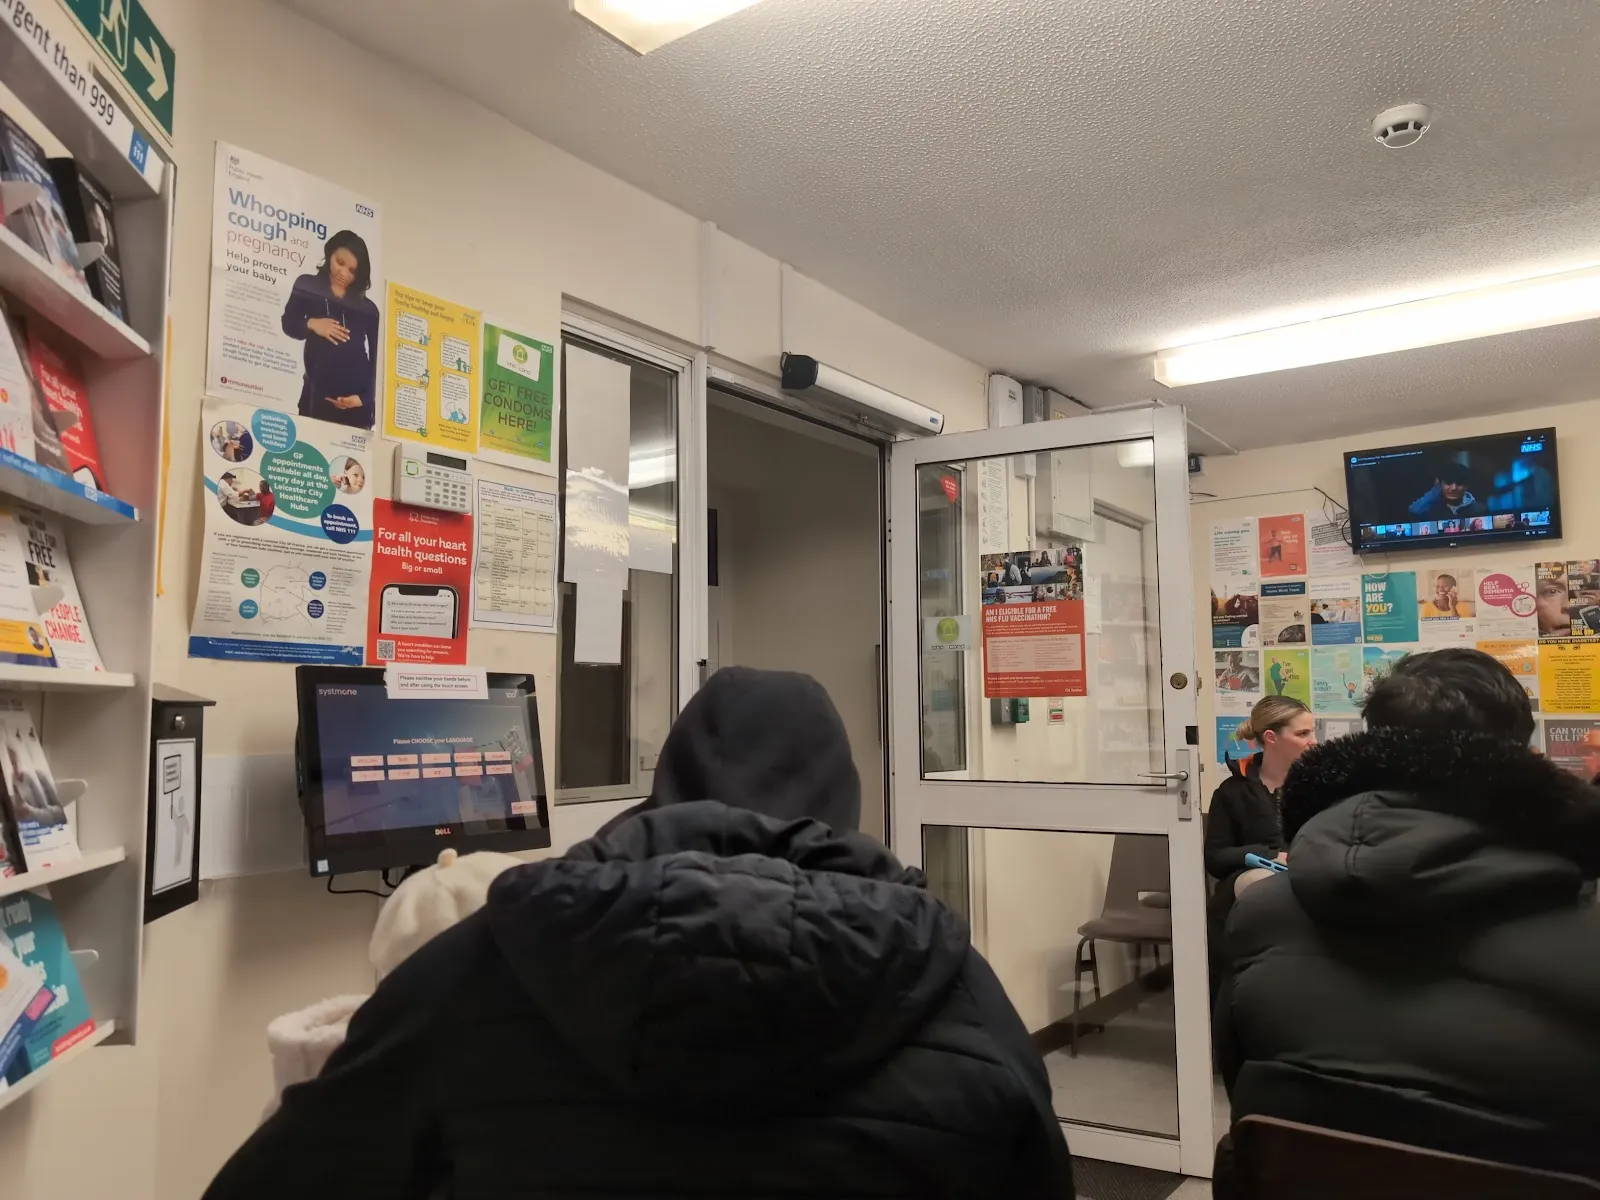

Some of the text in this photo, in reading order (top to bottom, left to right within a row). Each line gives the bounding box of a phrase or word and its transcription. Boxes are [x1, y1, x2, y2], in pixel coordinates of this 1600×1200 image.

[0, 0, 115, 126] rgent than 999
[133, 146, 144, 165] 111
[228, 187, 327, 240] Whooping
[356, 204, 374, 218] NHS
[228, 211, 309, 249] cough and
[227, 229, 306, 268] pregnancy
[226, 249, 288, 276] Help protect
[226, 262, 277, 285] your baby
[488, 378, 549, 406] GET FREE
[483, 392, 552, 421] CONDOMS
[260, 414, 287, 425] Including
[498, 411, 537, 433] HERE!
[260, 426, 288, 437] weekends
[262, 438, 286, 449] holidays
[1523, 443, 1542, 452] NHS
[272, 458, 323, 473] appointments
[267, 465, 329, 483] available all day,
[268, 474, 289, 484] every
[291, 478, 305, 487] day
[316, 482, 328, 490] the
[274, 483, 323, 499] Leicester City
[279, 492, 319, 505] Healthcare
[290, 502, 309, 512] Hubs
[378, 527, 467, 552] For all your heart
[27, 540, 56, 568] FREE
[377, 542, 412, 558] health
[414, 550, 467, 566] questions
[401, 562, 412, 572] Big
[423, 566, 443, 574] small
[1365, 582, 1386, 592] HOW
[1366, 592, 1384, 602] ARE
[49, 603, 82, 623] PEOPLE
[999, 607, 1024, 615] ELIGIBLE
[1025, 606, 1036, 614] FOR
[1042, 605, 1057, 613] FREE
[1365, 603, 1393, 613] YOU?
[986, 613, 1051, 623] NHS FLU VACCINATION?
[45, 620, 86, 644] CHANGE.
[318, 687, 357, 697] systmone
[1549, 727, 1590, 735] CAN YOU
[1573, 734, 1589, 742] IT'S
